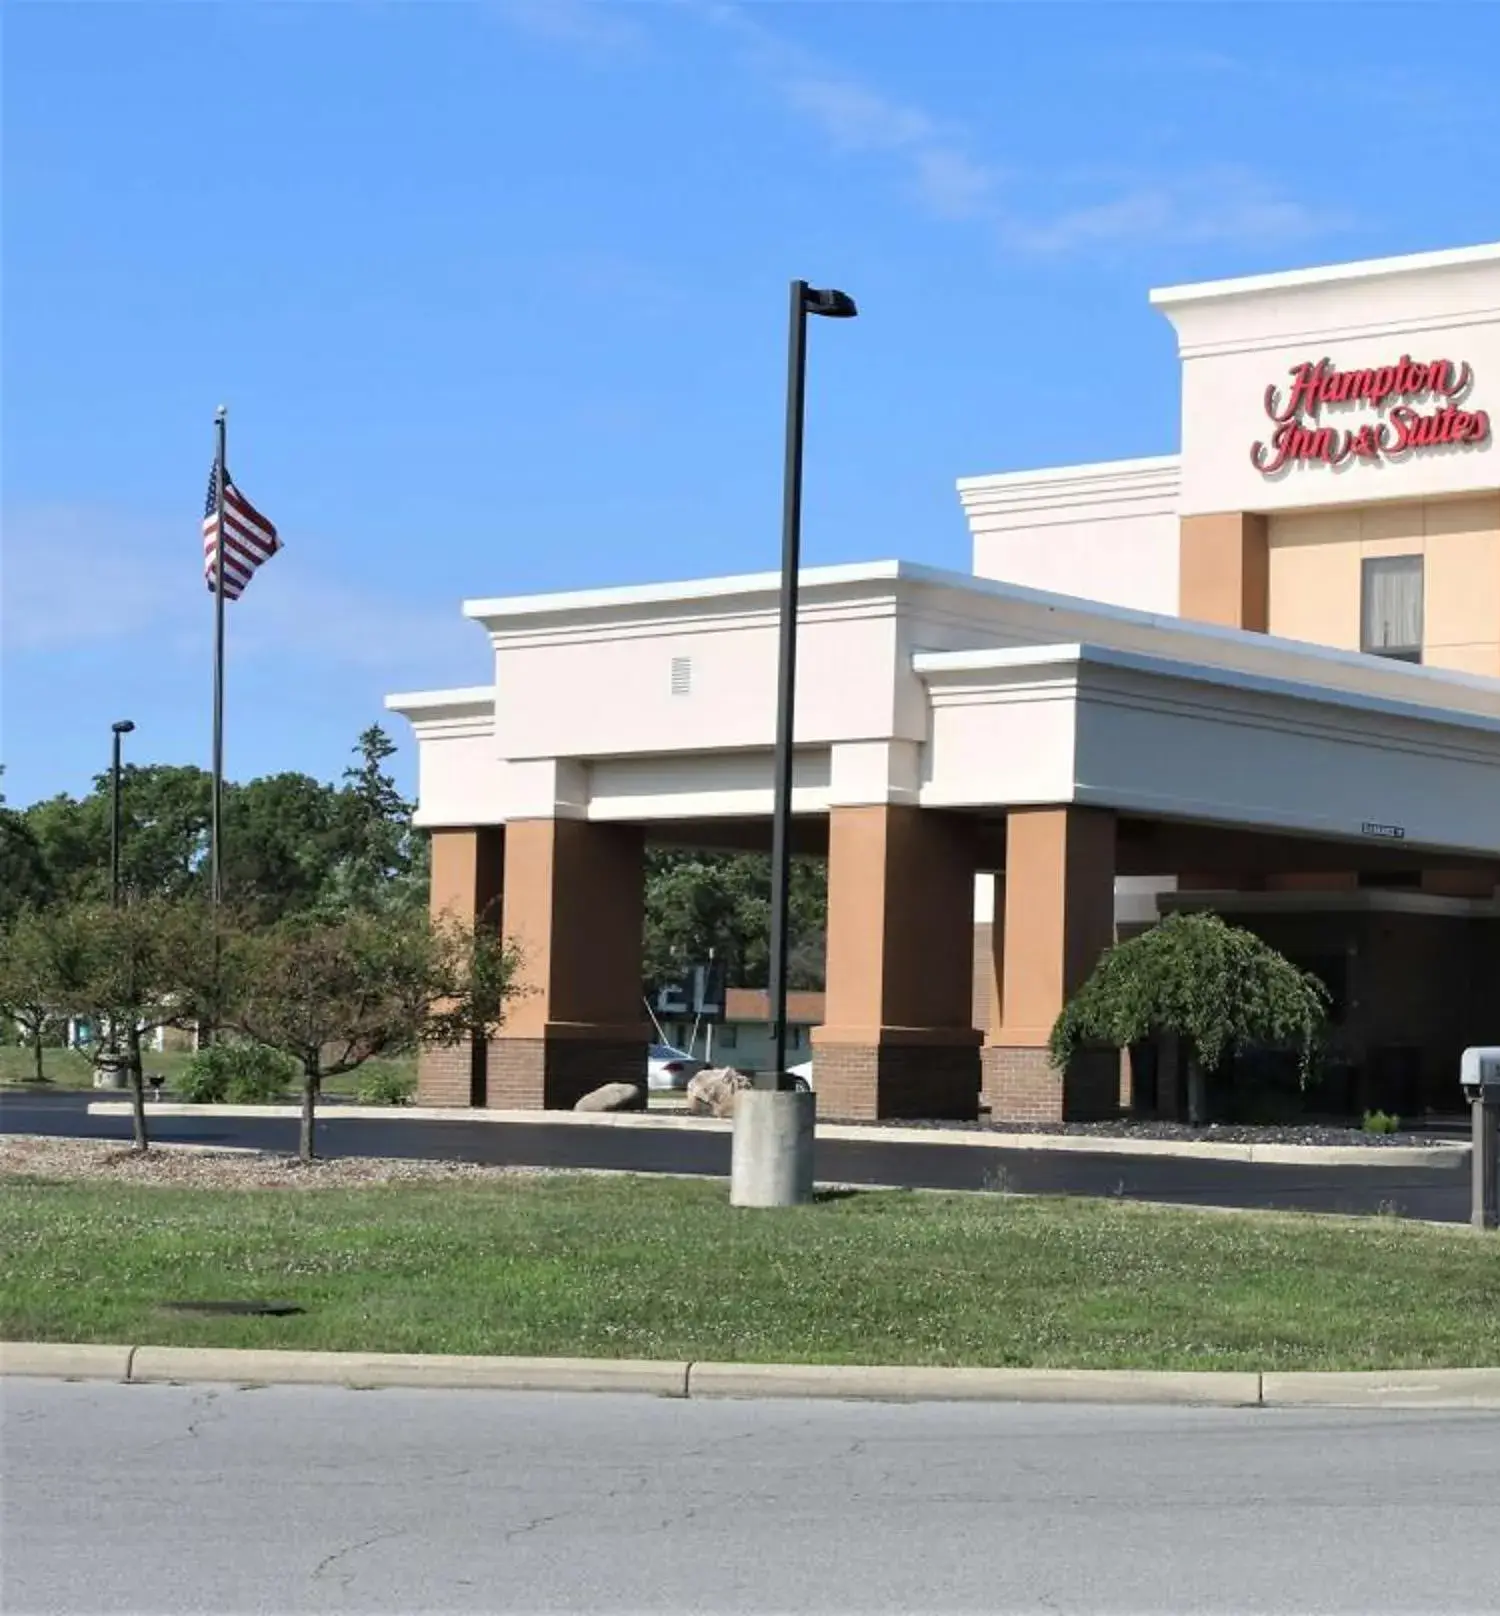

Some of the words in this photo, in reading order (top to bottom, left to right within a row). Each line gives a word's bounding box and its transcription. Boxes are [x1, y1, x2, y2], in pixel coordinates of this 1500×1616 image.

[1265, 354, 1474, 422] Hampton
[1250, 421, 1350, 472] Inn
[1350, 424, 1379, 457] &
[1375, 404, 1491, 455] Suites
